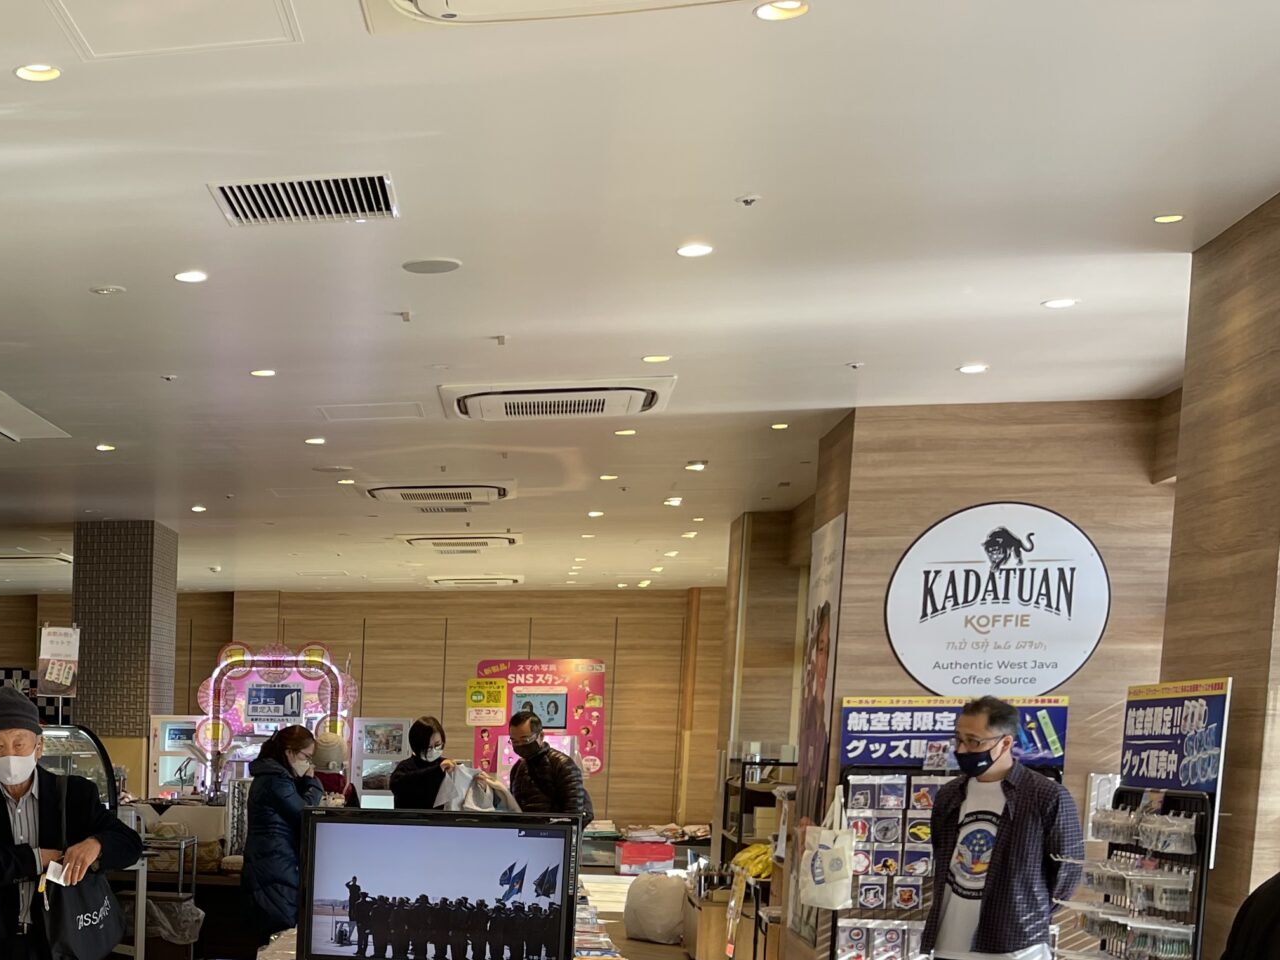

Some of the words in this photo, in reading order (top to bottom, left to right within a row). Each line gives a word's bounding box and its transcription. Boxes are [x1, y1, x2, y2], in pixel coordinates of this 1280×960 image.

[920, 567, 1076, 622] KADATUAN
[964, 614, 1031, 635] KOFFIE
[932, 660, 993, 670] Authentic
[997, 660, 1027, 670] West
[1030, 660, 1058, 670] Java
[952, 675, 991, 685] Coffee
[994, 675, 1037, 685] Source
[250, 697, 276, 705] PS5
[847, 711, 957, 732] 航空祭限定
[1122, 749, 1178, 780] グッズ販売中
